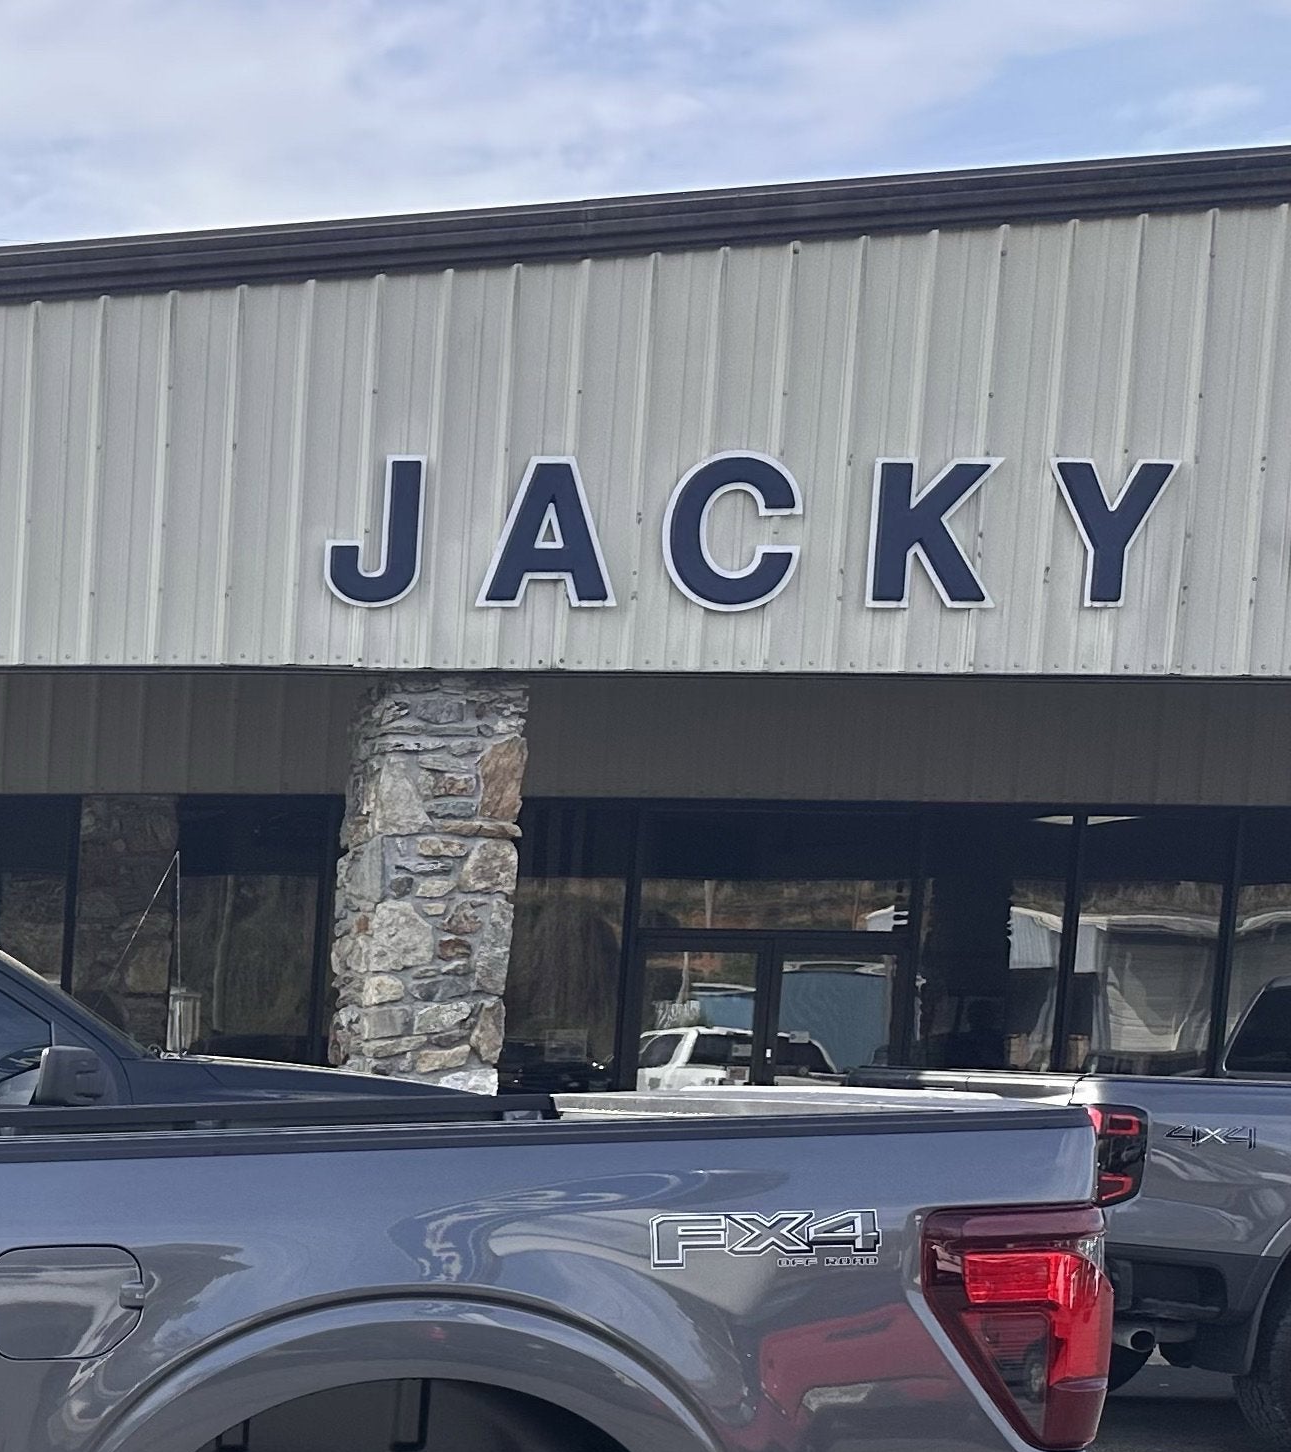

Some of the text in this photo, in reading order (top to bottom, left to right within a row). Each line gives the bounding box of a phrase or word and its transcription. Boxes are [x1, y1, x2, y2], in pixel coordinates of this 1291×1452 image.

[324, 450, 1181, 611] JACKY
[649, 1209, 882, 1269] FX4
[777, 1256, 878, 1267] OFF ROAD
